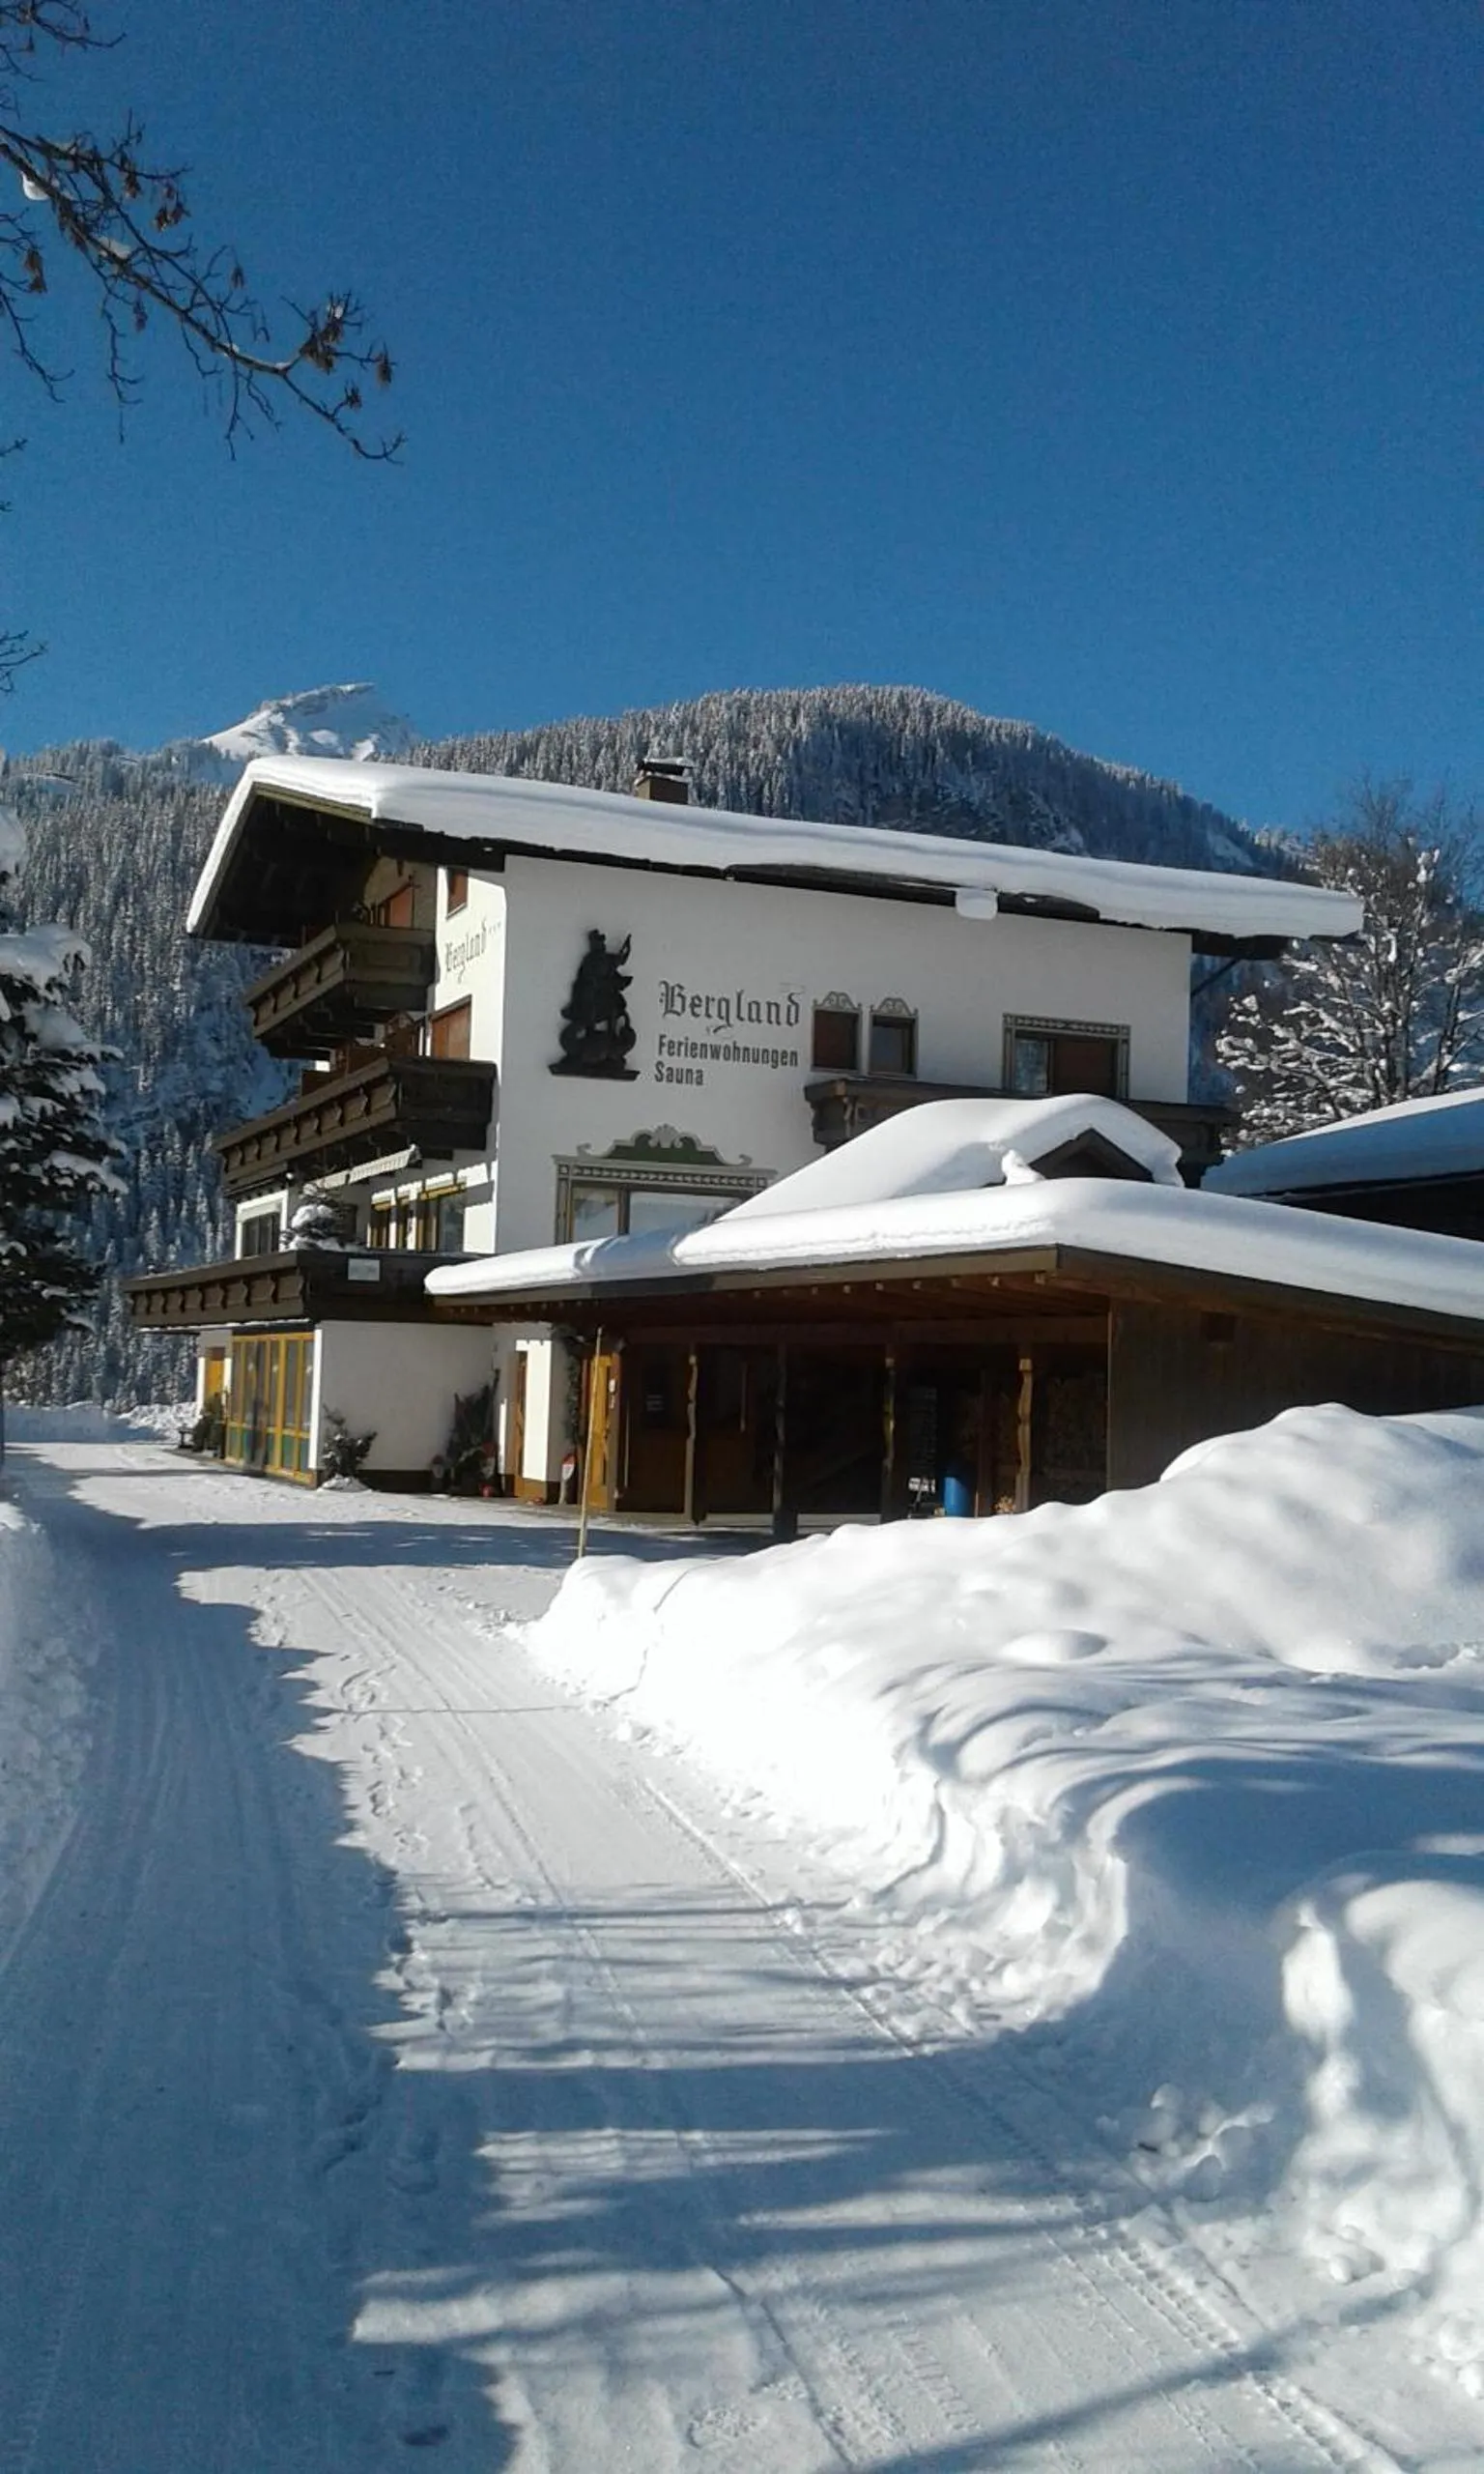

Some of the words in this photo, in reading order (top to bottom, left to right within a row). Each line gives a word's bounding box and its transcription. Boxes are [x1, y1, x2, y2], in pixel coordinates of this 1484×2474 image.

[444, 917, 487, 984] Bergland
[658, 980, 805, 1034] Bergland
[654, 1060, 704, 1086] Sauna
[658, 1034, 799, 1069] Ferienwohnungen
